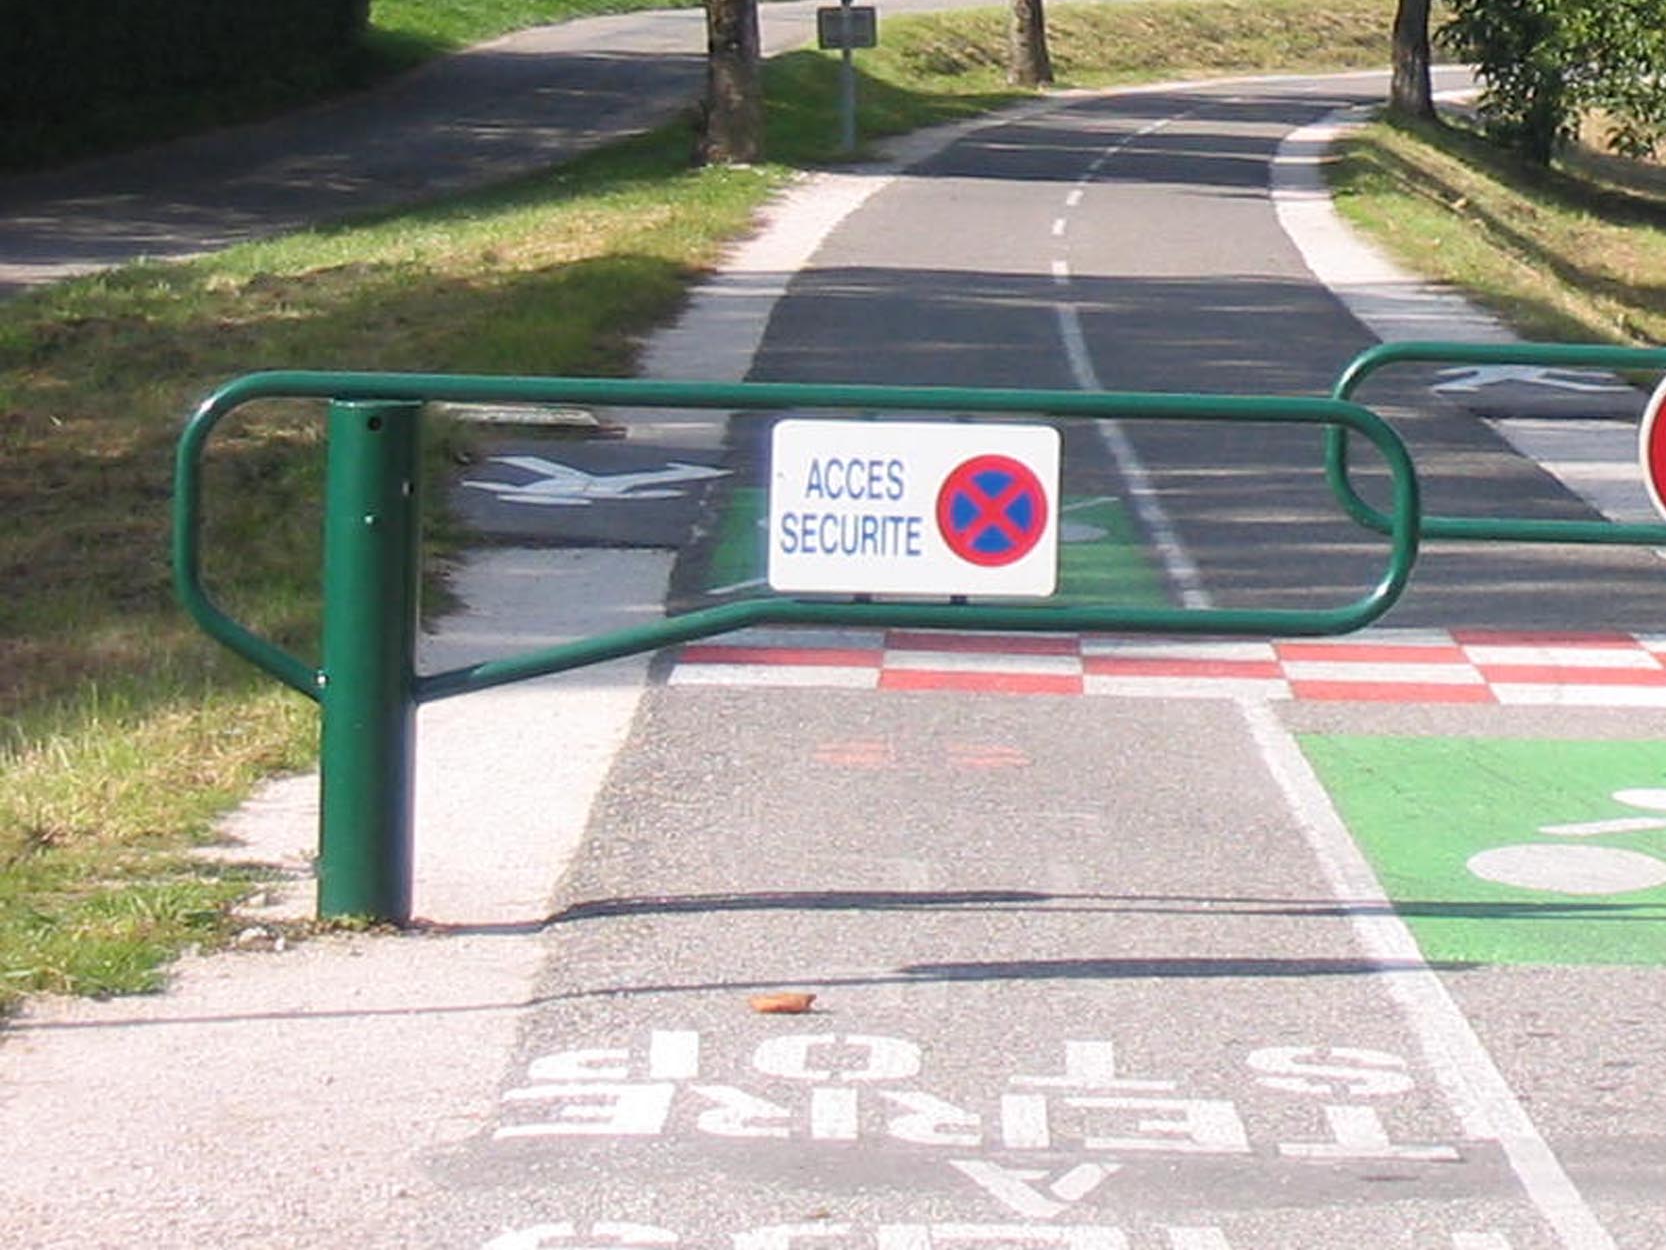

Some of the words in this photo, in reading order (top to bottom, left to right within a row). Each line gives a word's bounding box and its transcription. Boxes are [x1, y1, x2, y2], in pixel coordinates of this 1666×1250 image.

[804, 457, 905, 501] ACCES
[780, 512, 924, 557] SECURITE
[528, 1029, 1416, 1095] STOP
[494, 1082, 1461, 1161] TERRE
